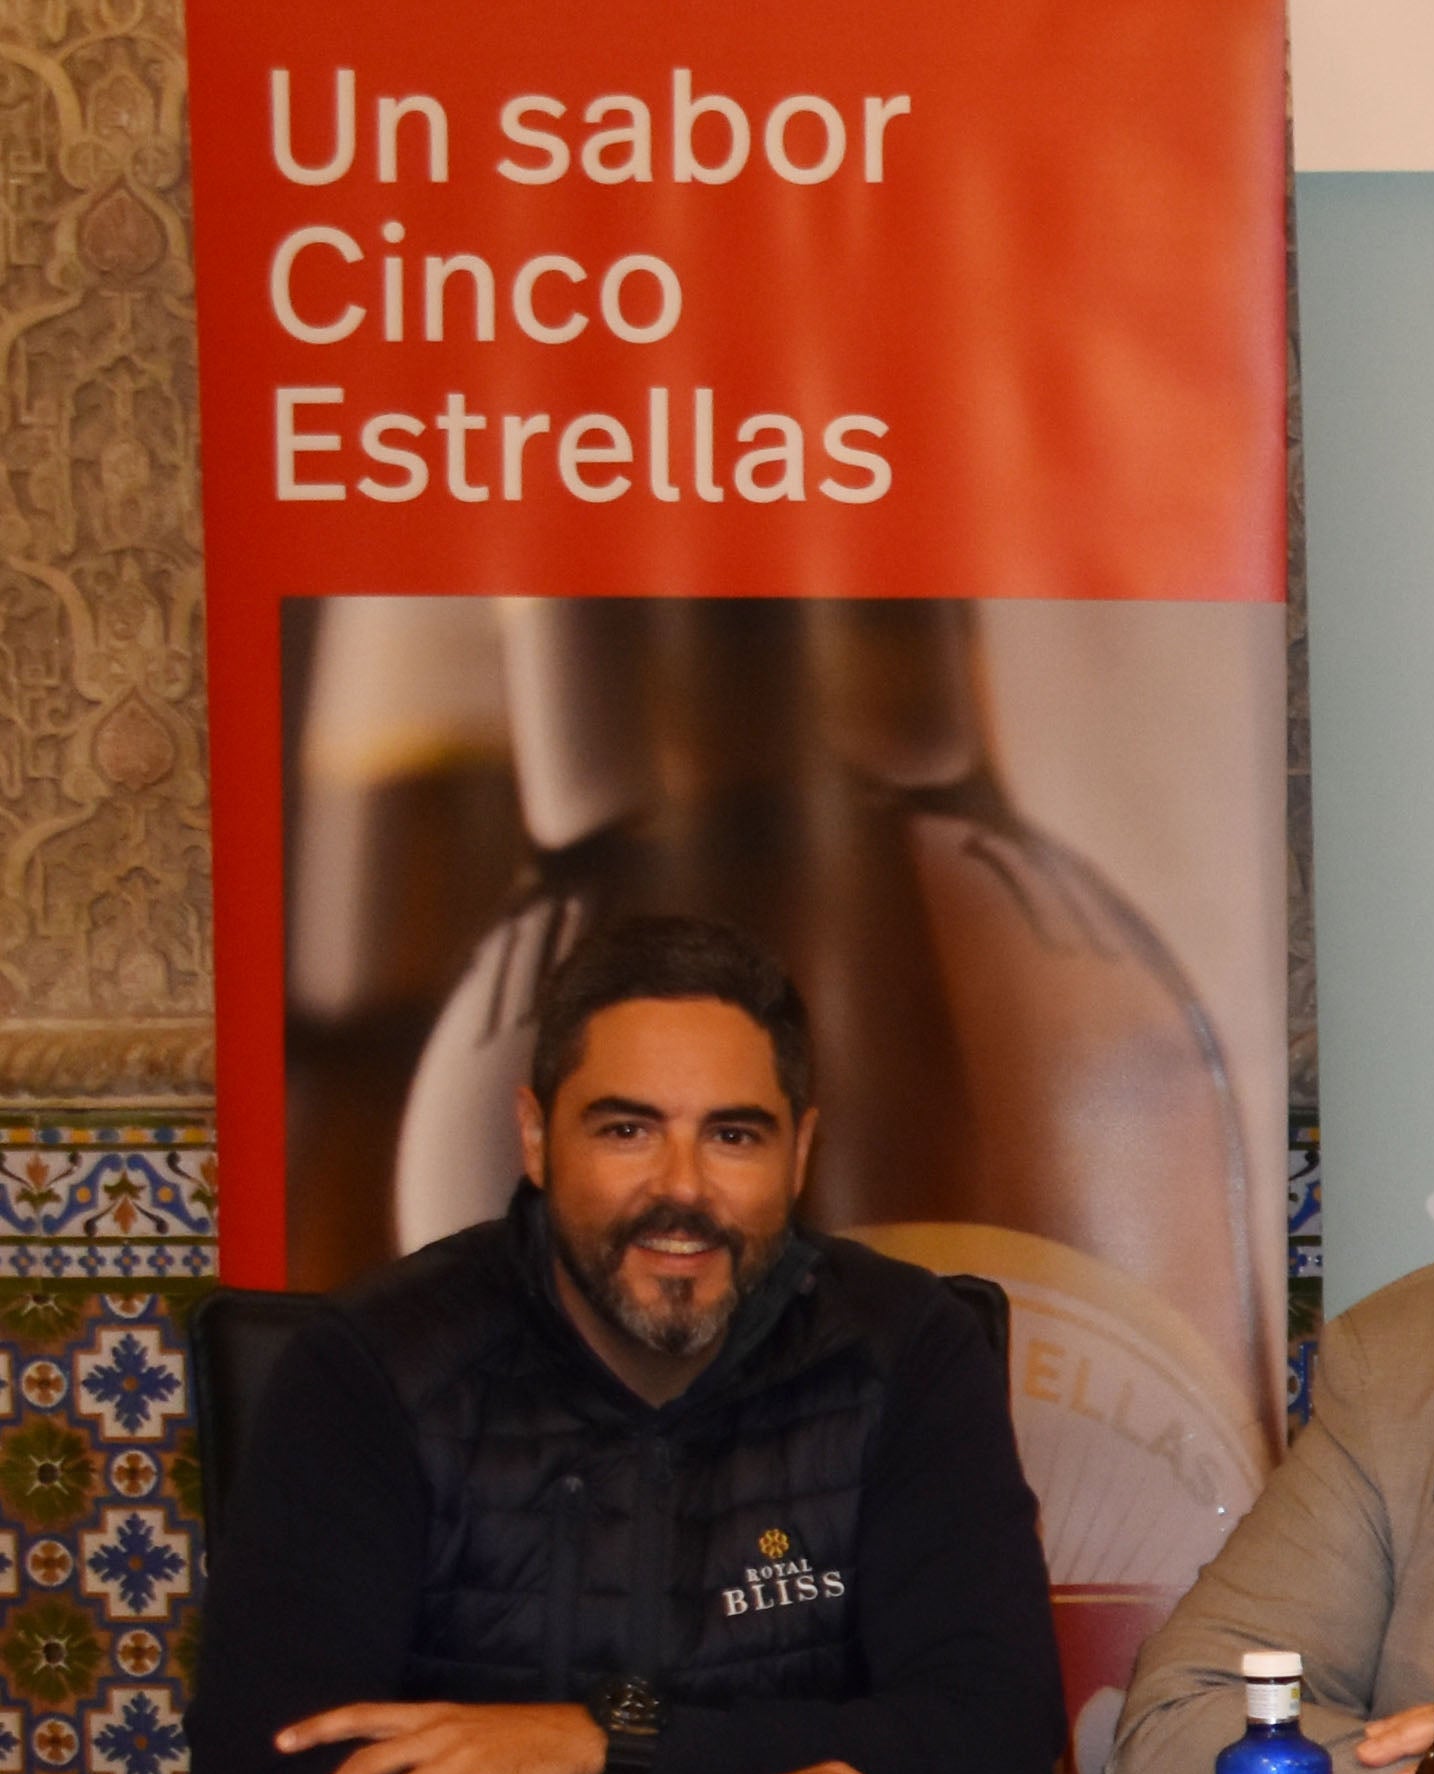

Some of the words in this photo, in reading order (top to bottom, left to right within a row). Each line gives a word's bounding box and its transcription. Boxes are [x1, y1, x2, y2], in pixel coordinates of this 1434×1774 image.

[271, 68, 448, 185] Un
[497, 68, 910, 185] sabor
[270, 221, 682, 344] Cinco
[276, 387, 891, 503] Estrellas
[721, 1569, 846, 1618] BLISS
[745, 1558, 814, 1583] ROYAL
